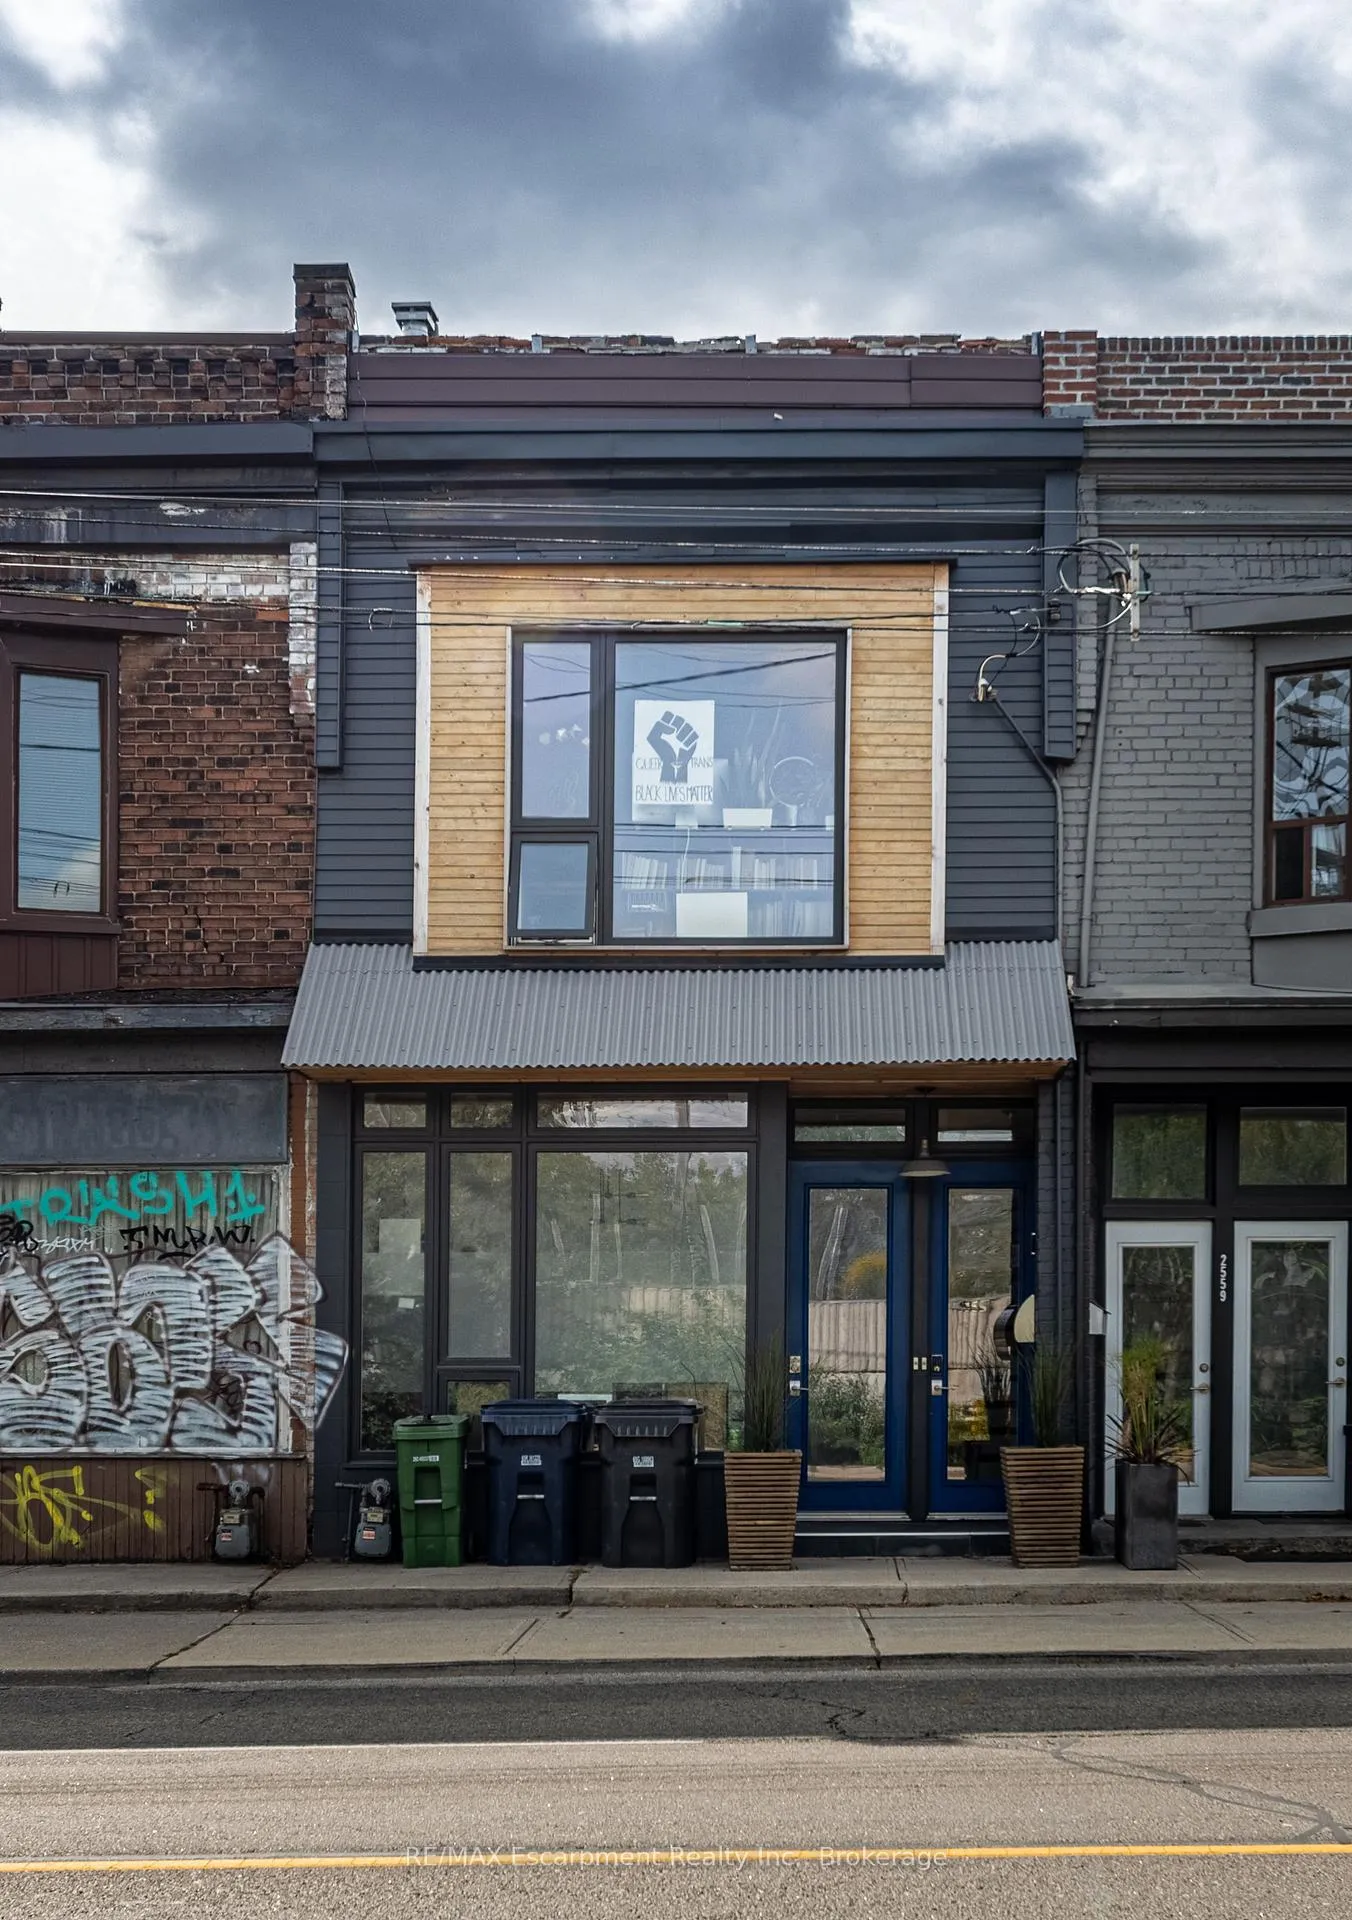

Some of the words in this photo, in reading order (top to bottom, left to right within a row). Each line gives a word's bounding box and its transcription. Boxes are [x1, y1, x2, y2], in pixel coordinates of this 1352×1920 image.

[691, 756, 714, 769] TRANS
[635, 784, 661, 801] BLACK
[665, 784, 685, 802] LIVES
[686, 784, 713, 802] MATTER
[1219, 1253, 1228, 1302] 2559
